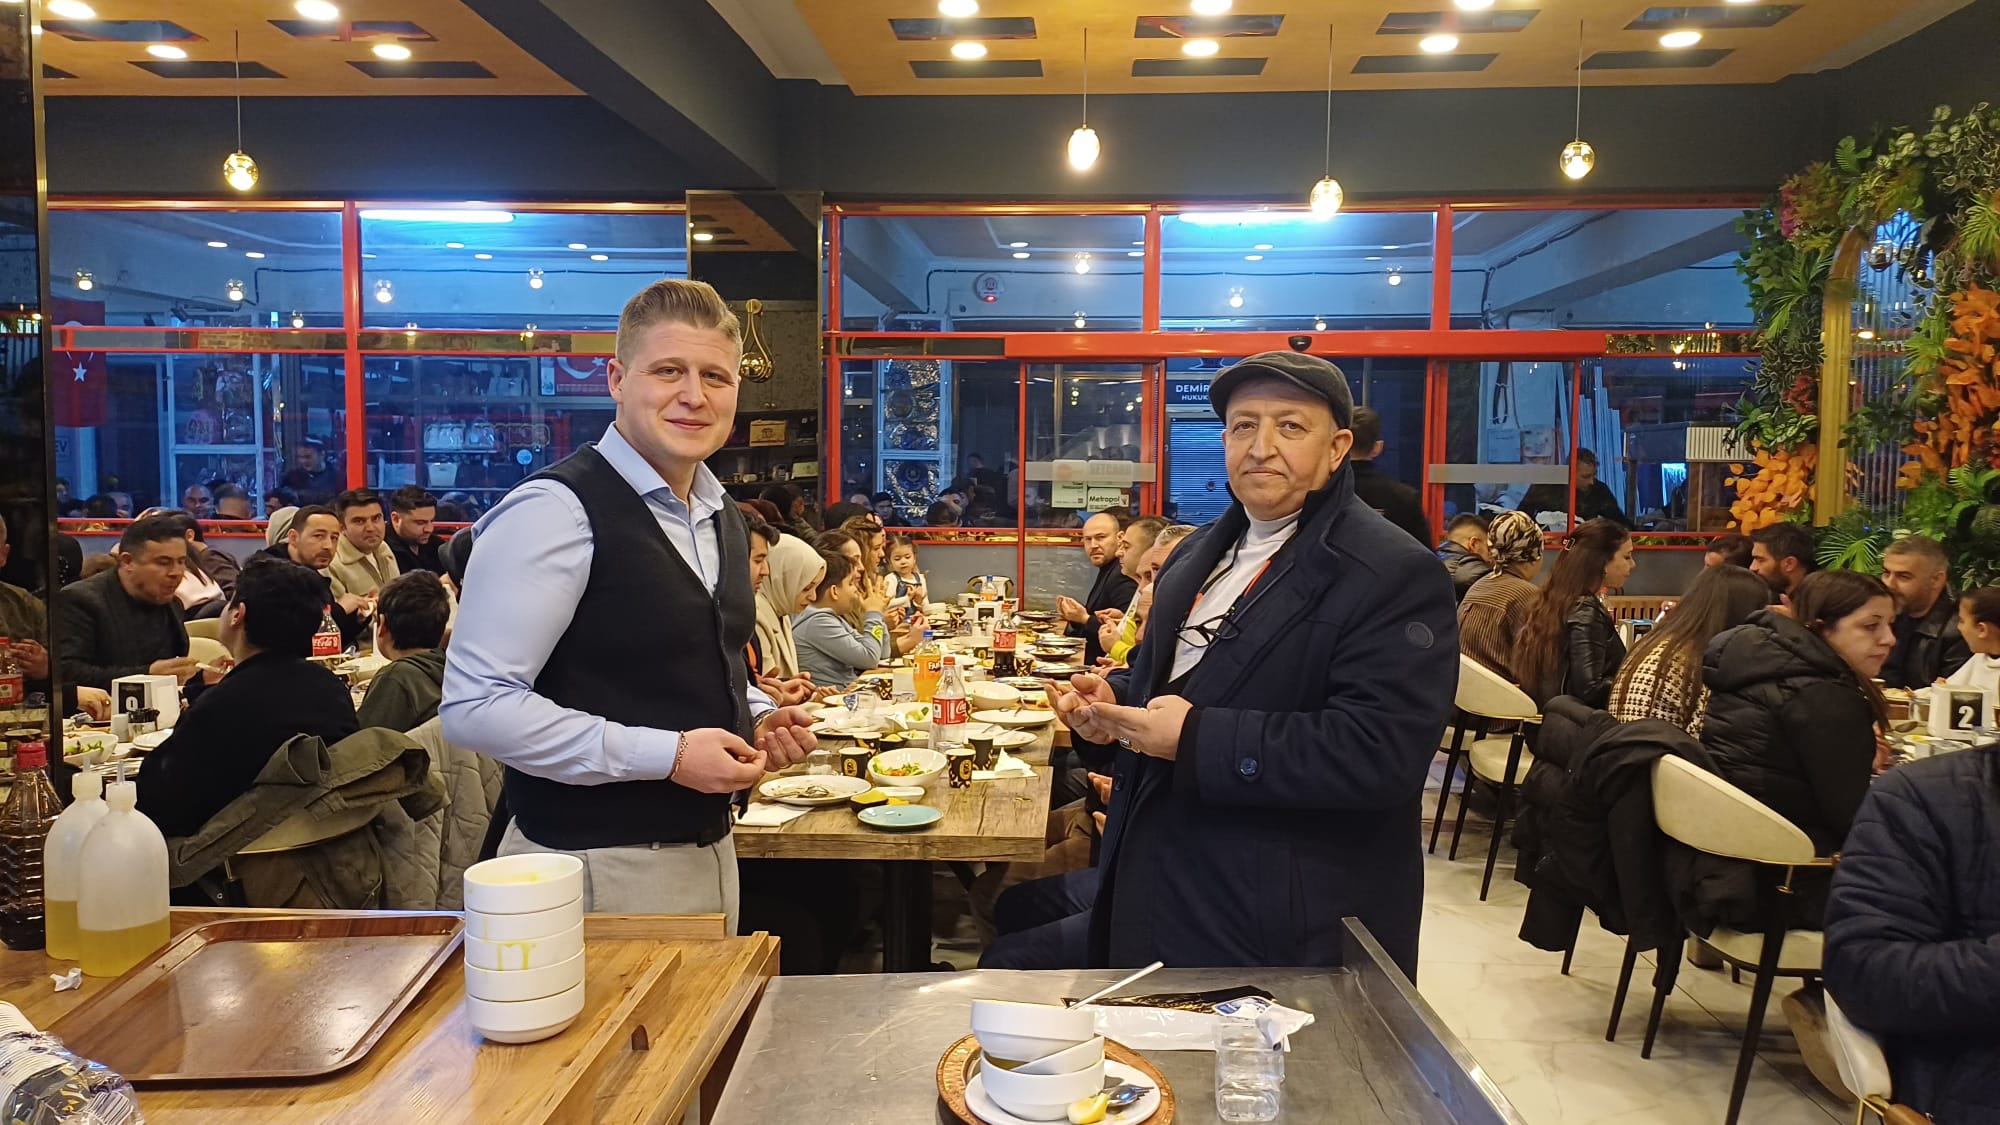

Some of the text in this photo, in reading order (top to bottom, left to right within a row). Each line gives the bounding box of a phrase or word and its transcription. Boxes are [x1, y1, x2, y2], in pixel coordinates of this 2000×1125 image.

[1175, 382, 1209, 393] DEMİR
[1089, 495, 1121, 504] Metropol
[1957, 705, 1975, 728] 2
